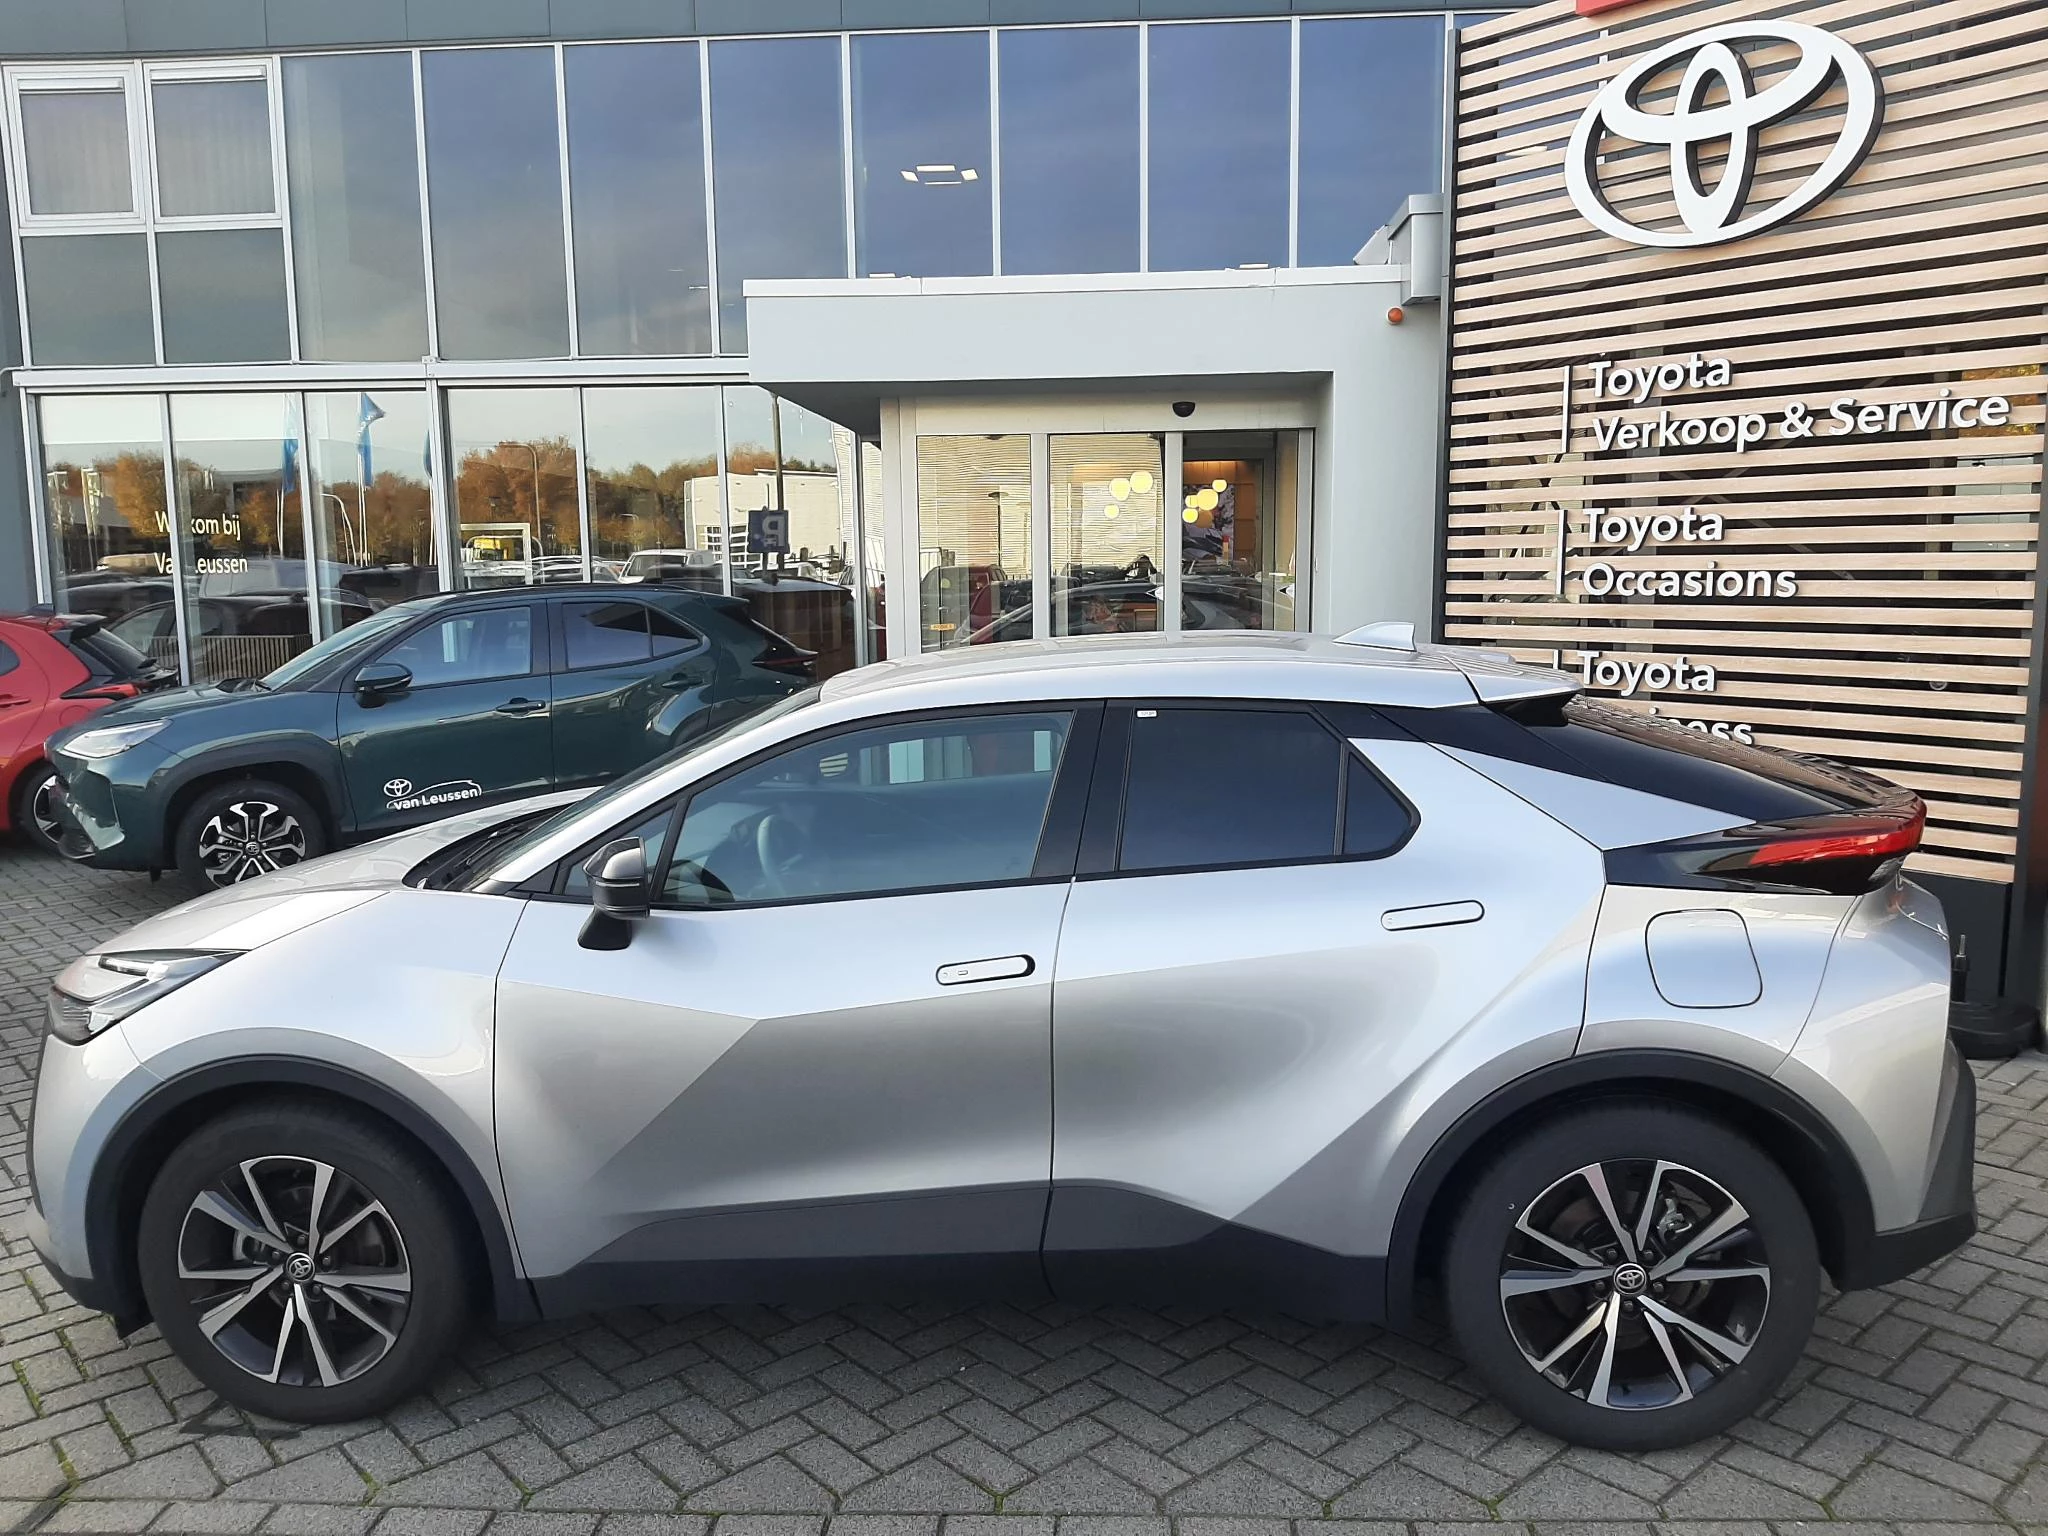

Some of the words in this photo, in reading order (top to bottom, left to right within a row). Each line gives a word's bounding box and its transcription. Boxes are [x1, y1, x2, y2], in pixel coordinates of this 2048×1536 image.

[1589, 353, 1732, 403] Toyota
[1592, 411, 1768, 453] Verkoop
[1779, 401, 1814, 438] &
[1829, 387, 2010, 435] Service
[155, 510, 220, 535] Wom
[222, 513, 241, 541] bij
[1583, 506, 1725, 552] Toyota
[154, 552, 174, 574] Va
[195, 557, 248, 574] eussen
[1583, 561, 1798, 598] Occasions
[1577, 650, 1717, 697] Toyota
[393, 798, 420, 811] van
[421, 788, 478, 806] Leussen
